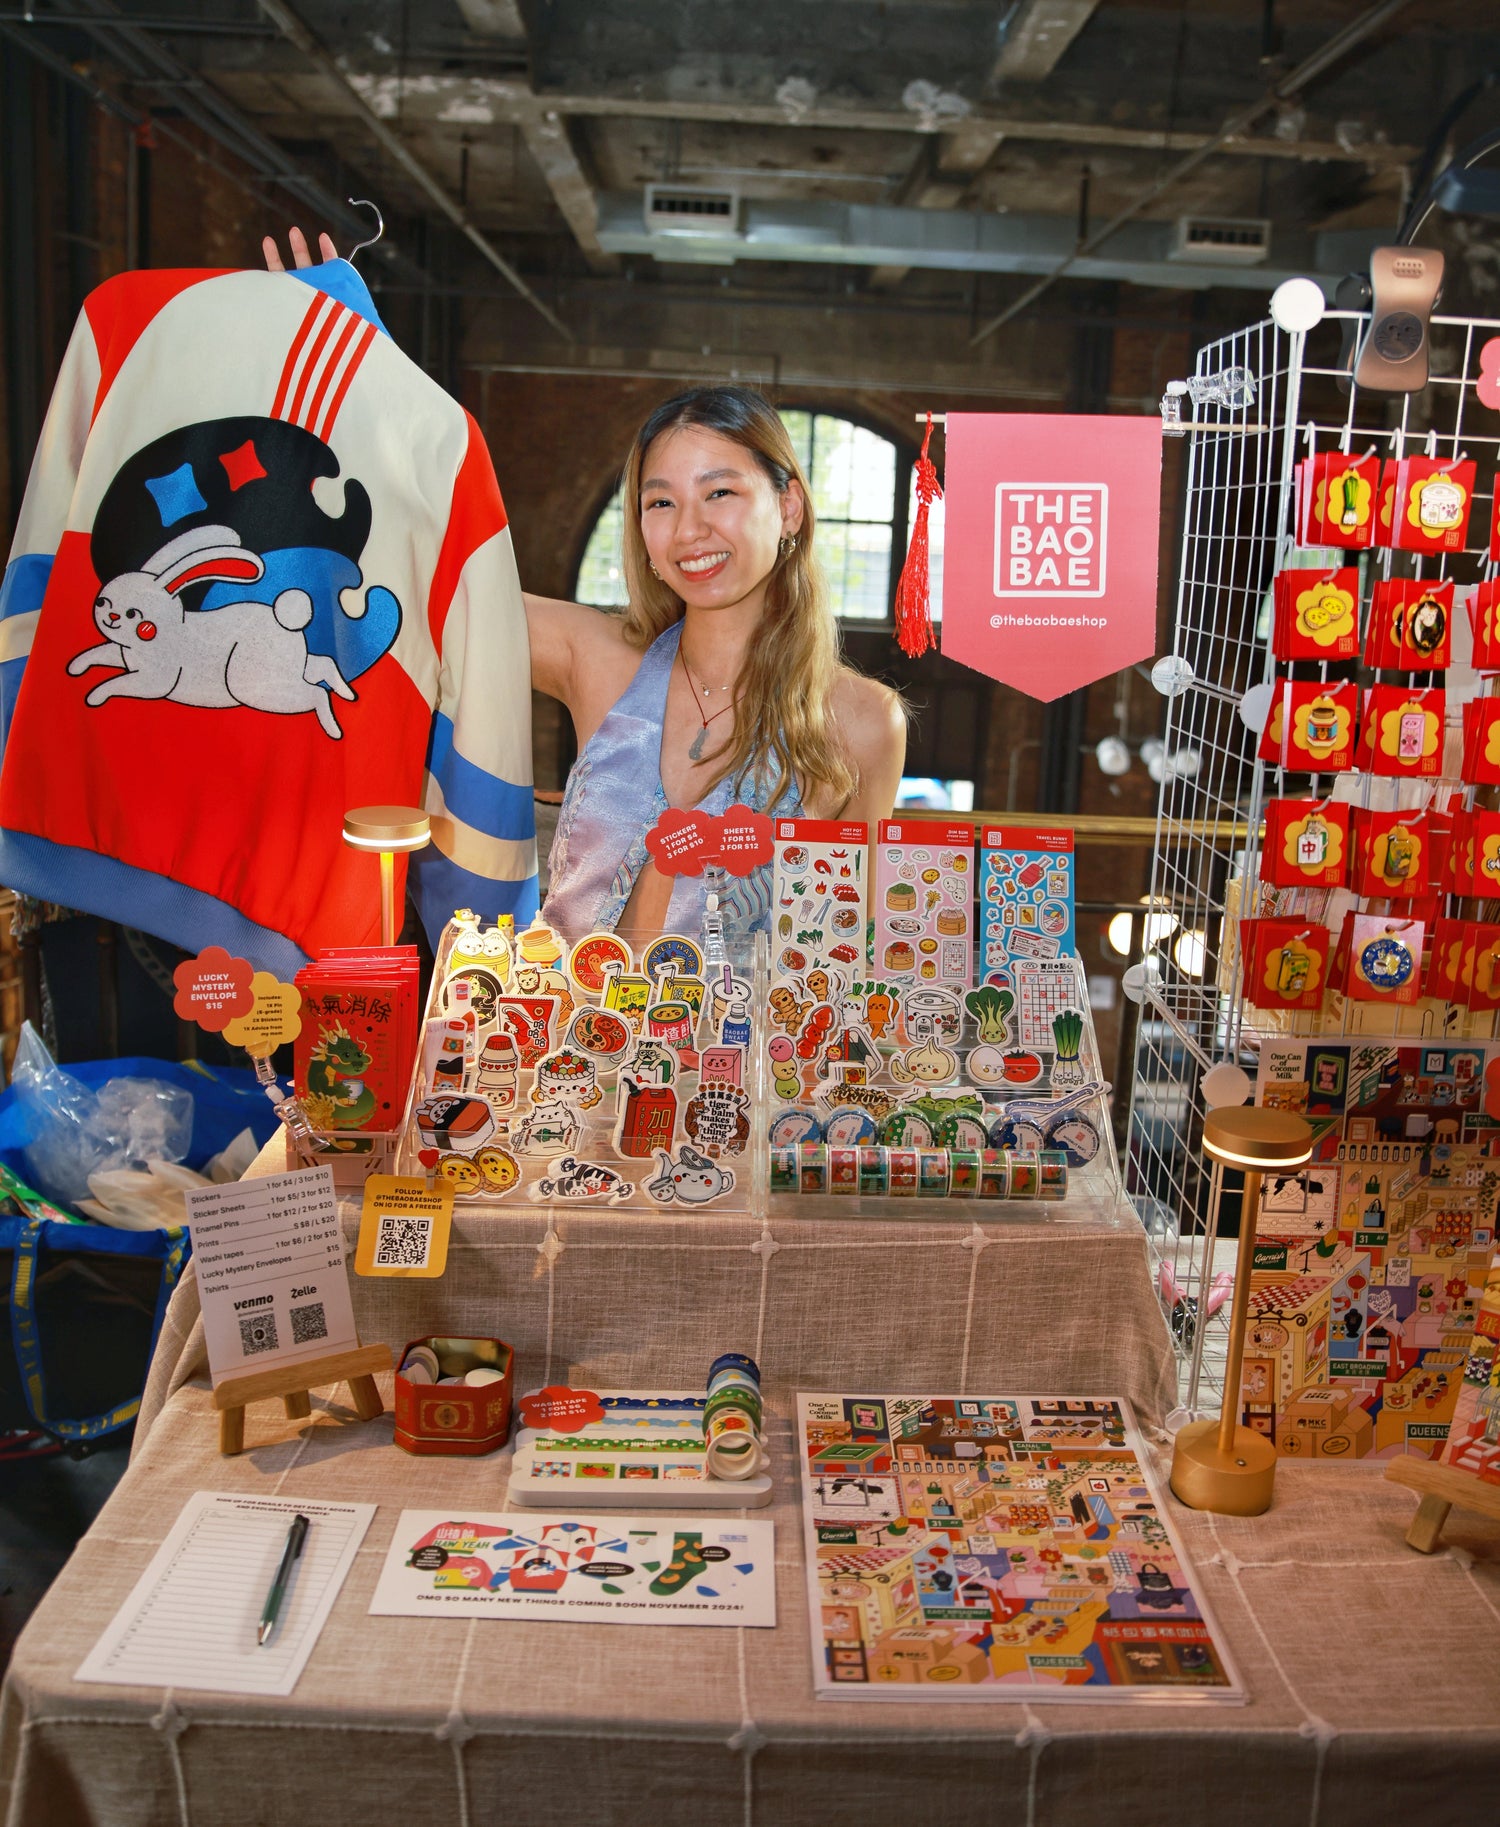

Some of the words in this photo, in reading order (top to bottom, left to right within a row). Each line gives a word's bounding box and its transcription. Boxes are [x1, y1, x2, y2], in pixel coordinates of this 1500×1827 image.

[1009, 494, 1092, 524] THE
[1010, 525, 1093, 556] BAO
[1010, 557, 1091, 587] BAE
[990, 614, 1107, 628] @thebaobaeshop
[660, 824, 697, 844] STICKERS
[671, 837, 686, 848] FOR
[688, 832, 698, 841] $4
[673, 846, 689, 856] FOR
[689, 839, 704, 849] $10
[1301, 840, 1316, 860] 中
[582, 942, 604, 955] YEET
[652, 943, 672, 959] YEET
[676, 945, 693, 958] HAY
[198, 973, 229, 981] LUCKY
[192, 983, 235, 991] MYSTERY
[191, 992, 237, 1001] ENVELOPE
[205, 1002, 223, 1010] $15
[709, 1100, 730, 1110] tiger
[701, 1115, 730, 1123] makes
[711, 1108, 734, 1118] balm
[703, 1127, 728, 1138] thing
[710, 1123, 733, 1132] every
[192, 1193, 220, 1204] Stickers
[283, 1179, 293, 1187] $4
[315, 1172, 329, 1180] $10
[193, 1209, 219, 1219] Sticker
[220, 1204, 245, 1214] Sheets
[275, 1195, 286, 1203] for
[306, 1189, 317, 1197] for
[318, 1186, 331, 1195] $12
[376, 1195, 442, 1203] @THEBAOBAESHOP
[196, 1224, 223, 1234] Enamel
[224, 1220, 240, 1229] Pins
[283, 1208, 297, 1217] $12
[308, 1204, 318, 1212] for
[319, 1201, 333, 1209] $20
[198, 1240, 219, 1249] Prints
[300, 1220, 310, 1229] $8
[321, 1215, 335, 1224] $20
[1359, 1235, 1368, 1243] 31
[200, 1254, 223, 1264] Washi
[224, 1250, 244, 1260] tapes
[292, 1237, 302, 1245] $6
[308, 1234, 312, 1242] 2
[313, 1233, 323, 1241] for
[324, 1230, 337, 1239] $10
[202, 1269, 224, 1279] Lucky
[225, 1263, 255, 1275] Mystery
[256, 1255, 292, 1268] Envelopes
[327, 1244, 340, 1253] $15
[1255, 1251, 1285, 1263] Garnish
[204, 1284, 229, 1294] Tshirts
[328, 1258, 342, 1268] $45
[290, 1285, 317, 1299] Zelle
[234, 1294, 274, 1311] venmo
[1410, 1427, 1449, 1436] QUEENS
[649, 1602, 709, 1610] NOVEMBER
[1032, 1658, 1083, 1666] QUEENS
